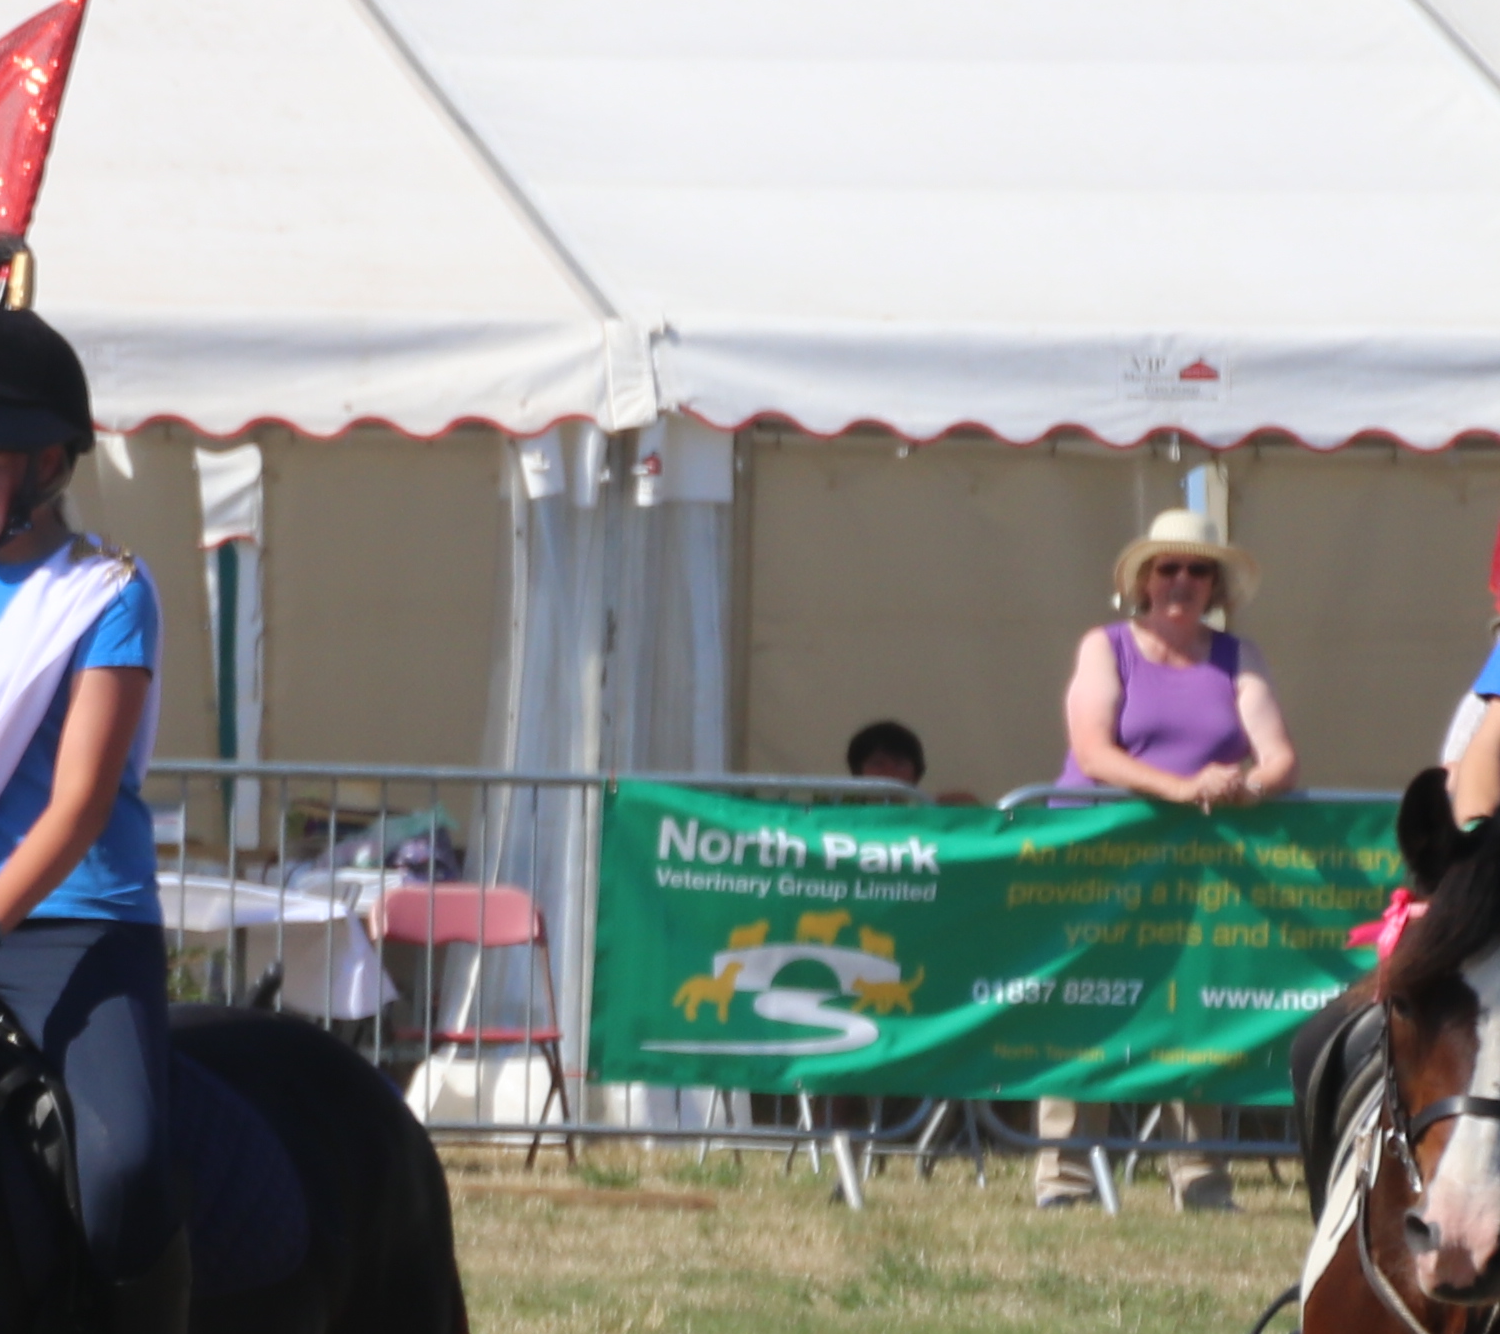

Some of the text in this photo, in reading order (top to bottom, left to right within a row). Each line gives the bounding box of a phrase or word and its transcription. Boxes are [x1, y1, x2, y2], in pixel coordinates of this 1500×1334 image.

[657, 816, 941, 875] North Park
[1015, 838, 1402, 876] An independent veterinary
[656, 866, 938, 903] Veterinary Group Limited
[1006, 878, 1385, 912] providing a high standard
[1063, 921, 1130, 948] your
[1135, 919, 1203, 949] pets
[1212, 919, 1270, 948] and
[972, 977, 1057, 1006] 01837
[1062, 978, 1145, 1006] 82327
